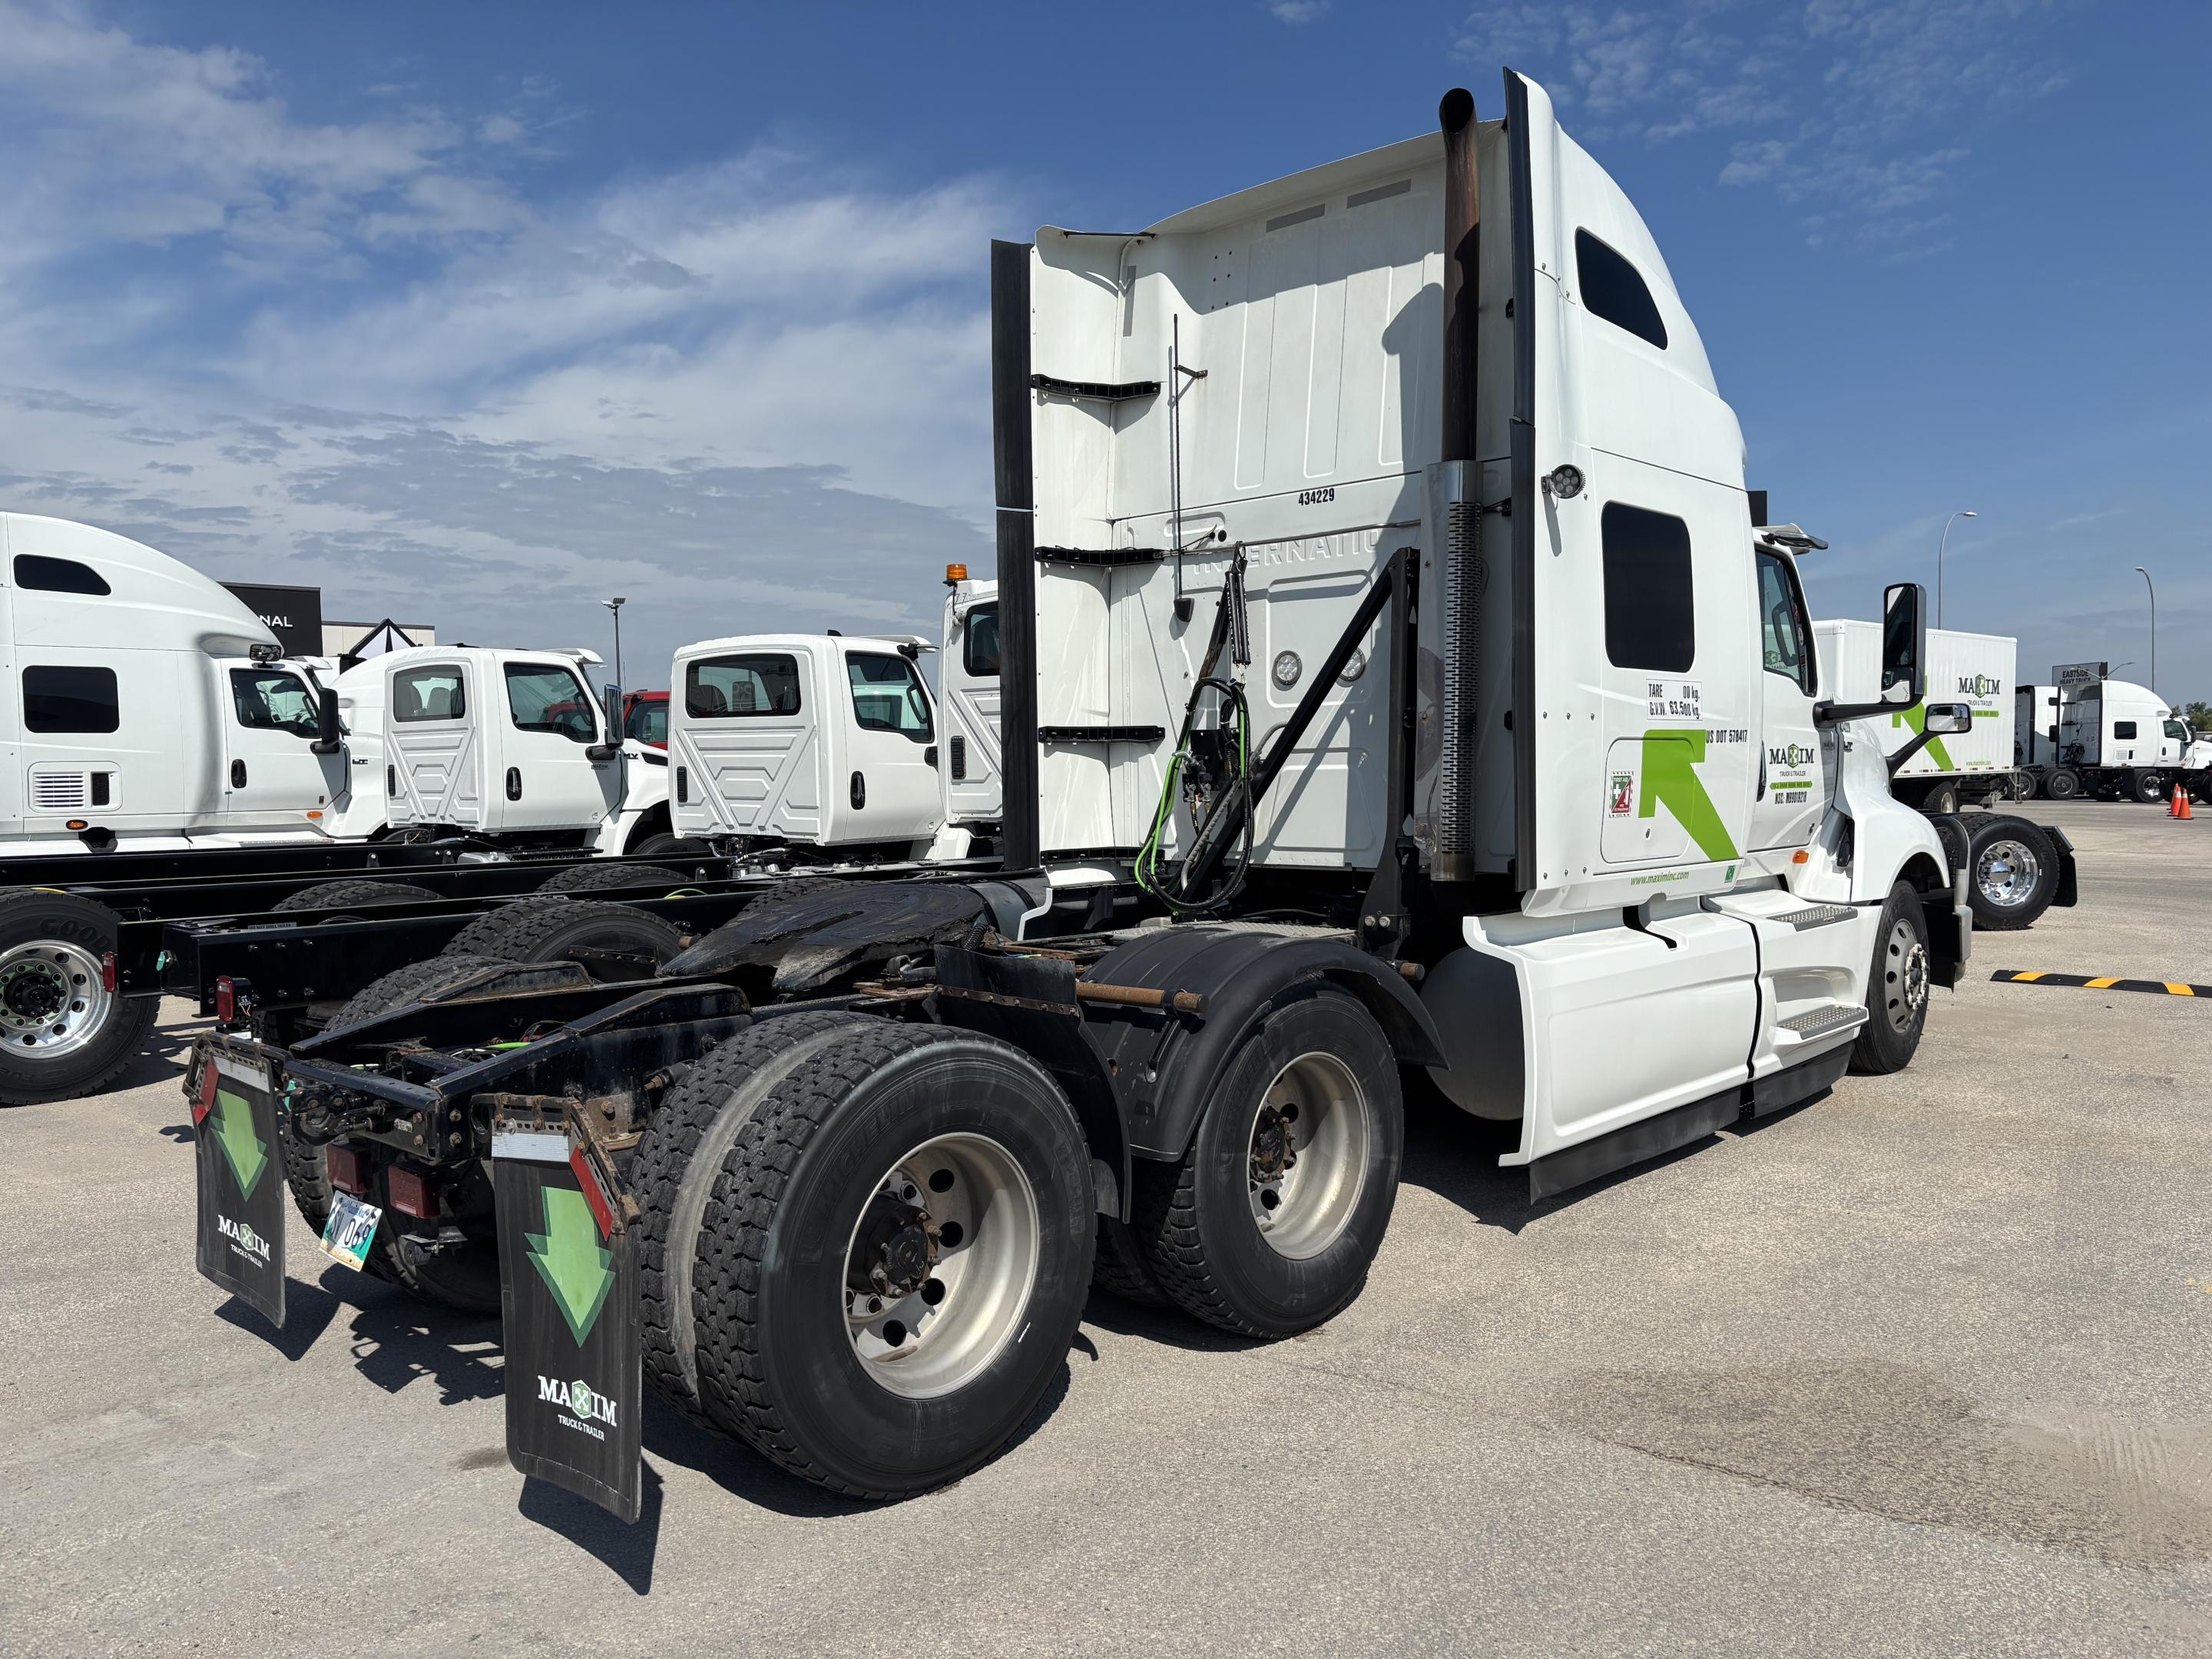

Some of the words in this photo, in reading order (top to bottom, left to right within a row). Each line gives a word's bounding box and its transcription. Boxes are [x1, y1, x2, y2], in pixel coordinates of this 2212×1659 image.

[1298, 488, 1335, 505] 434229
[2062, 668, 2089, 678] EASTSIDE
[1648, 684, 1663, 698] TARE
[1683, 685, 1690, 699] 00
[1691, 685, 1700, 702] kg.
[1958, 674, 2001, 698] MAXIM
[1649, 701, 1667, 716] G.V.W.
[1669, 700, 1691, 717] 63,500
[1691, 704, 1701, 720] kg.
[1706, 730, 1714, 743] US
[1716, 730, 1727, 743] DOT
[1729, 729, 1748, 743] 578417
[1770, 743, 1815, 769] MAXIM
[1630, 870, 1690, 886] www.maximinc.com
[217, 1214, 270, 1261] MAXIM
[344, 1217, 372, 1251] 069
[230, 1243, 245, 1257] TRUCK
[247, 1253, 263, 1268] TRAILER
[538, 1375, 618, 1427] MAXIM
[558, 1414, 578, 1430] TRUCK
[582, 1422, 605, 1442] TRAILER
